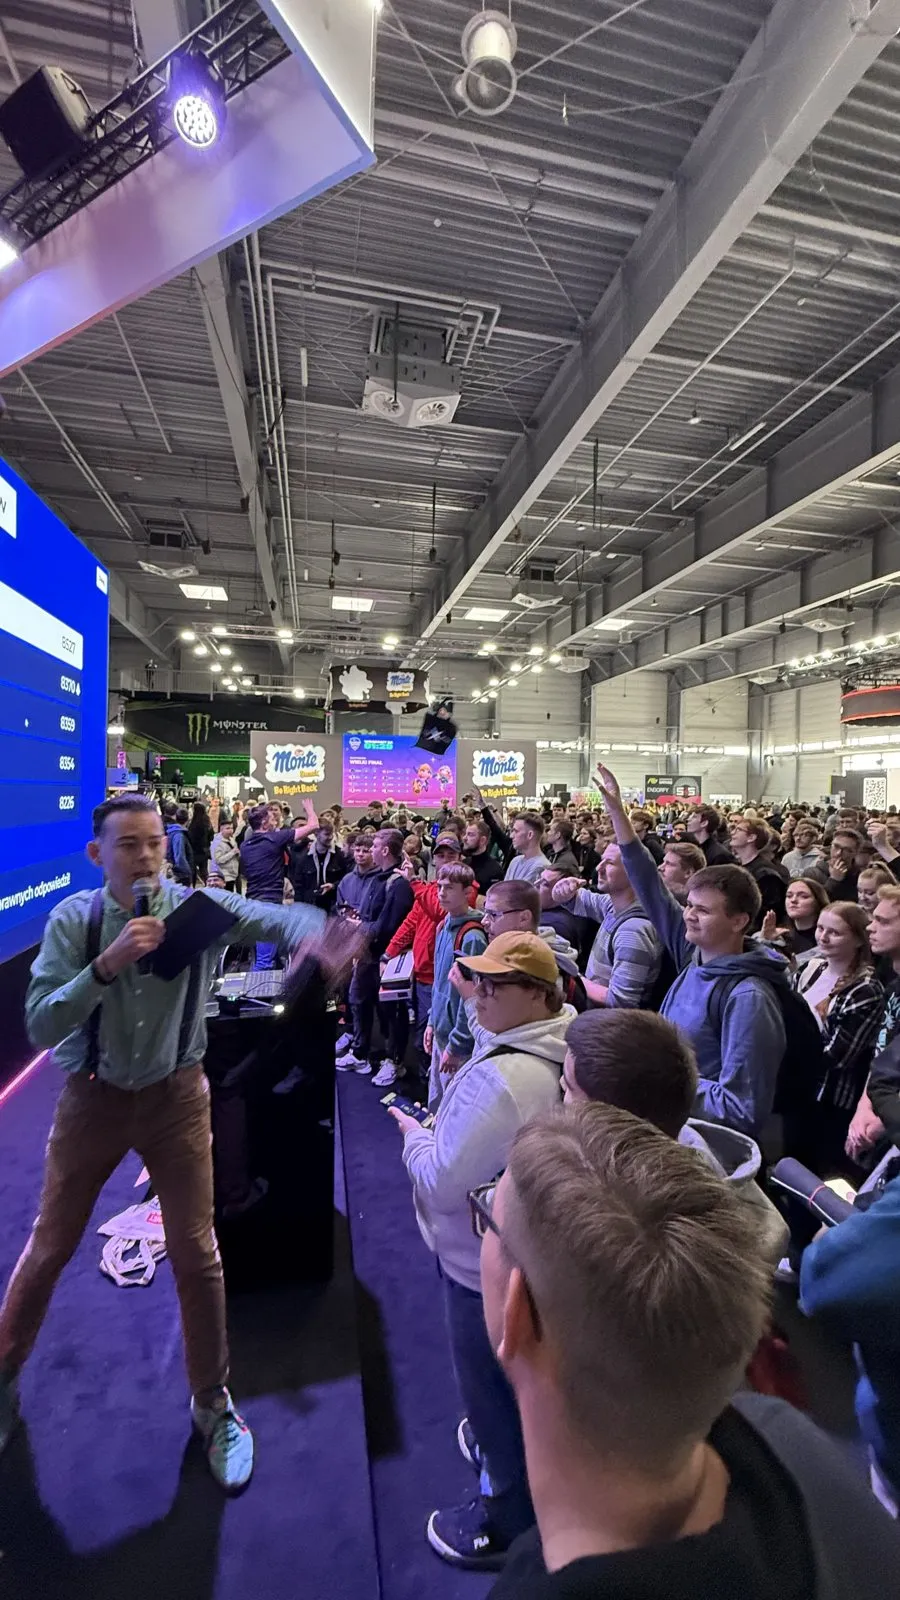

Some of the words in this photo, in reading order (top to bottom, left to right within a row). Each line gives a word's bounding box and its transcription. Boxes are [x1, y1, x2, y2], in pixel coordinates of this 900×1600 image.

[213, 720, 268, 730] MONSTER
[272, 750, 317, 773] Monte
[478, 756, 518, 777] Monte
[273, 785, 283, 795] Be
[283, 784, 301, 796] Right
[301, 783, 319, 793] Back
[488, 788, 503, 798] Right
[503, 787, 518, 796] Back
